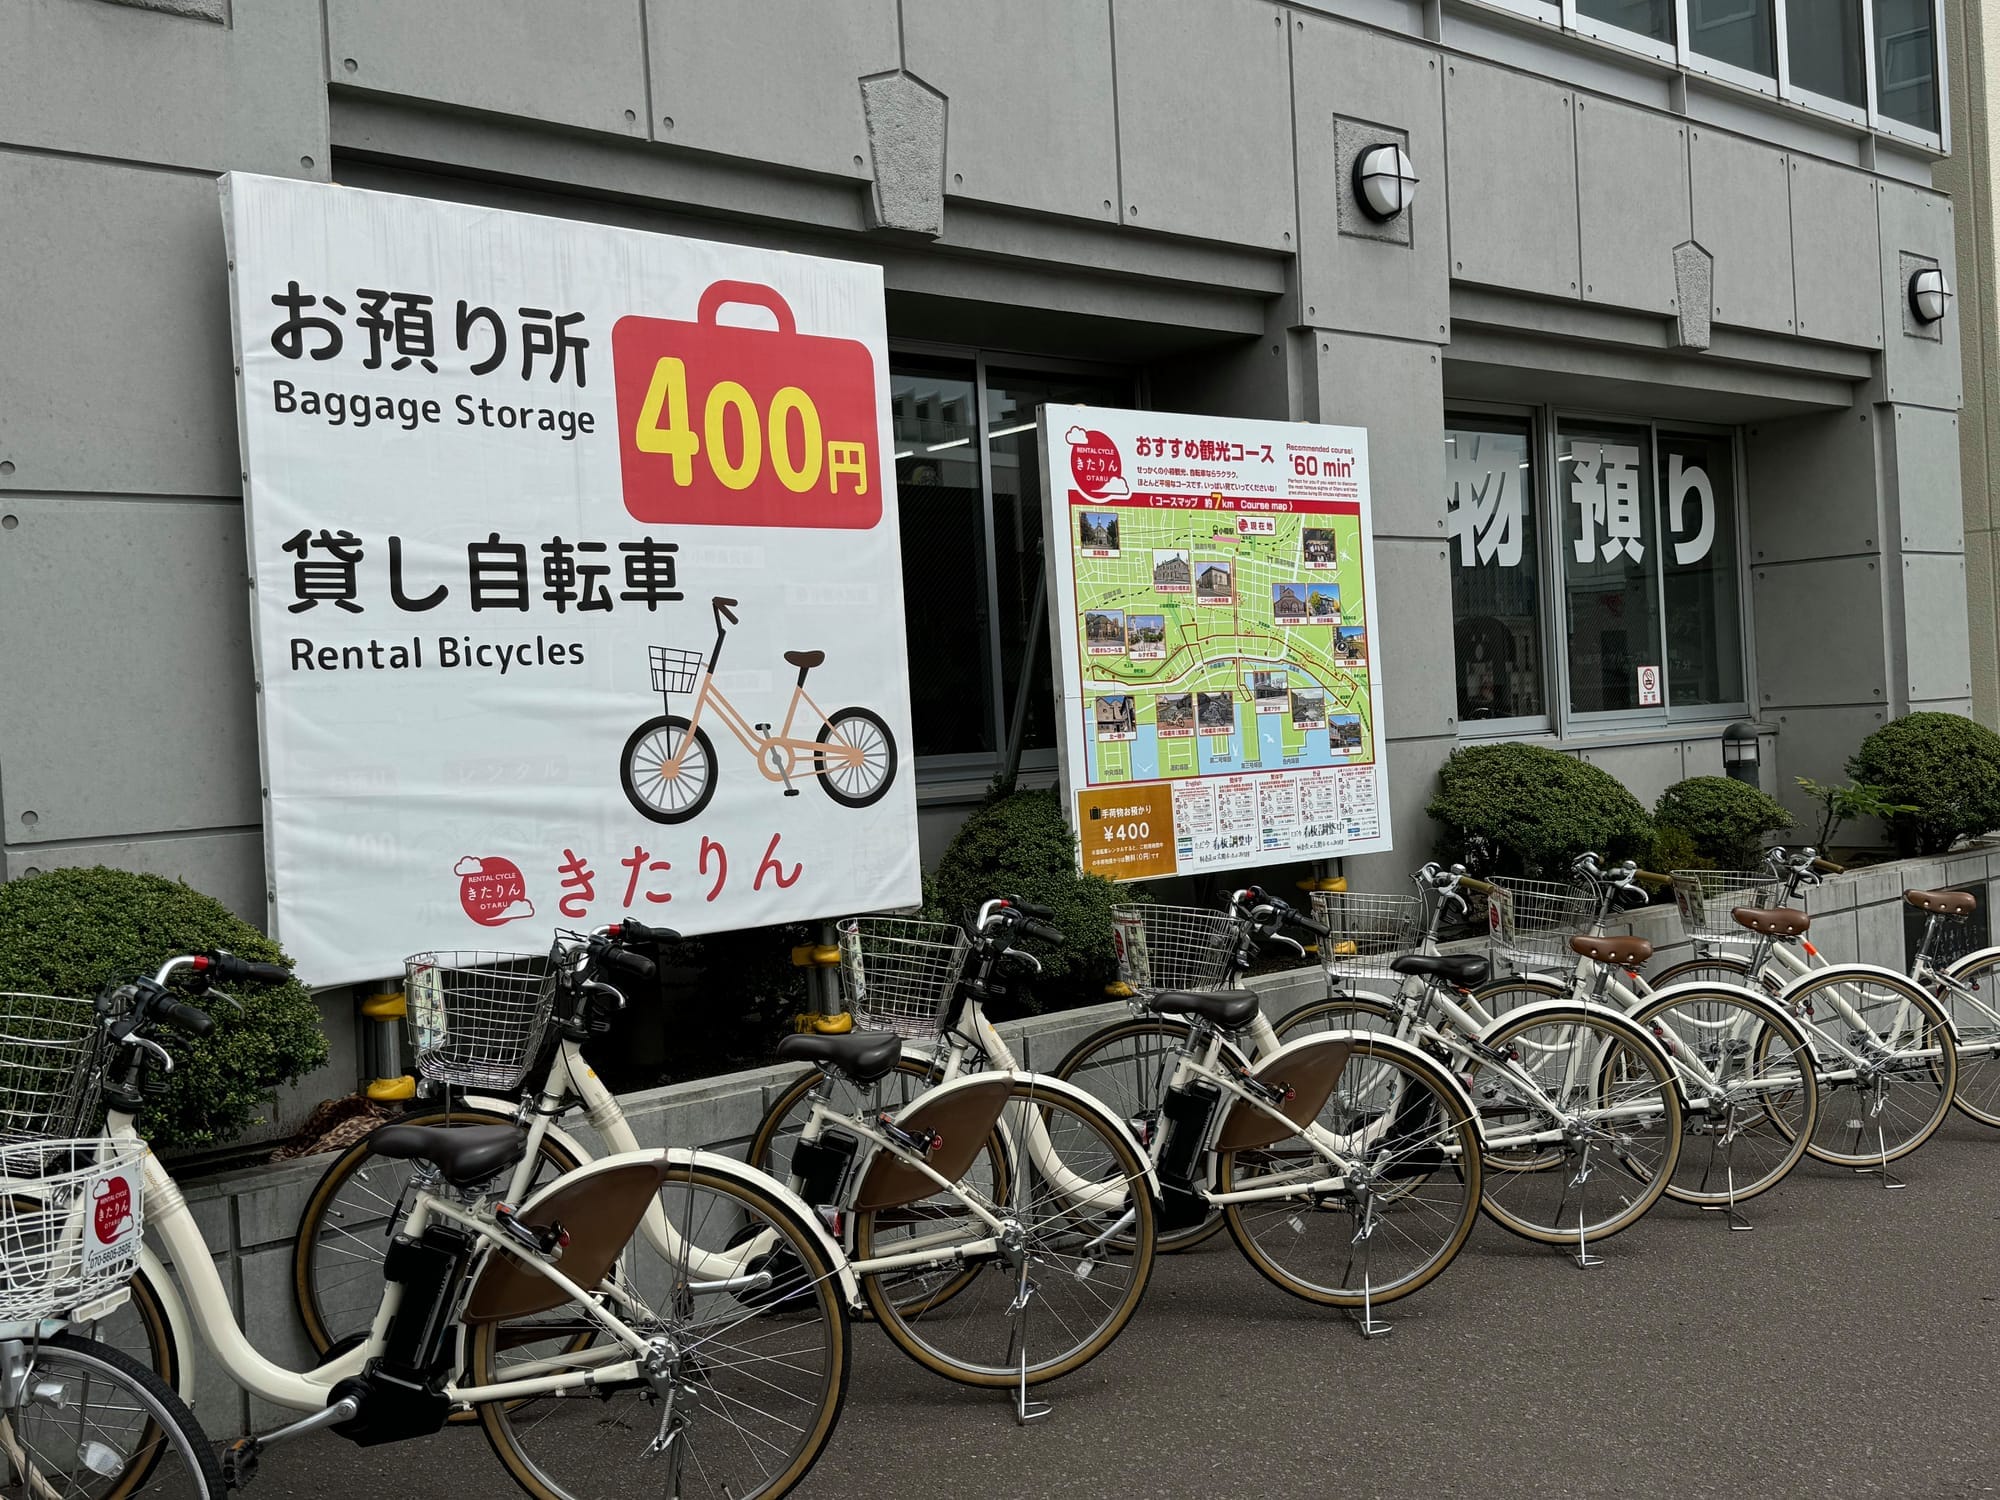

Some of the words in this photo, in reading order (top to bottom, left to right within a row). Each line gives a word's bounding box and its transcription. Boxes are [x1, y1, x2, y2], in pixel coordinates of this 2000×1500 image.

[271, 281, 589, 388] お預り所
[273, 380, 441, 428] Baggage
[456, 395, 596, 441] Storage
[1098, 448, 1115, 456] CYCLE
[1136, 436, 1275, 464] おすすめ観光コース
[1286, 443, 1330, 453] Recommended
[1077, 457, 1118, 472] きたりん
[1241, 500, 1270, 510] Course
[1250, 521, 1273, 531] 現在地
[282, 529, 684, 615] 貸し自転車
[290, 637, 422, 671] Rental
[438, 634, 585, 675] Bicycles
[1101, 804, 1151, 819] 手荷物お預かり
[1104, 821, 1150, 842] ¥400
[468, 875, 494, 883] RENTAL
[496, 872, 516, 881] CYCLE
[557, 832, 803, 918] きたりん
[467, 882, 521, 901] きたりん
[479, 901, 508, 910] OTARU
[98, 1200, 129, 1222] きたりん
